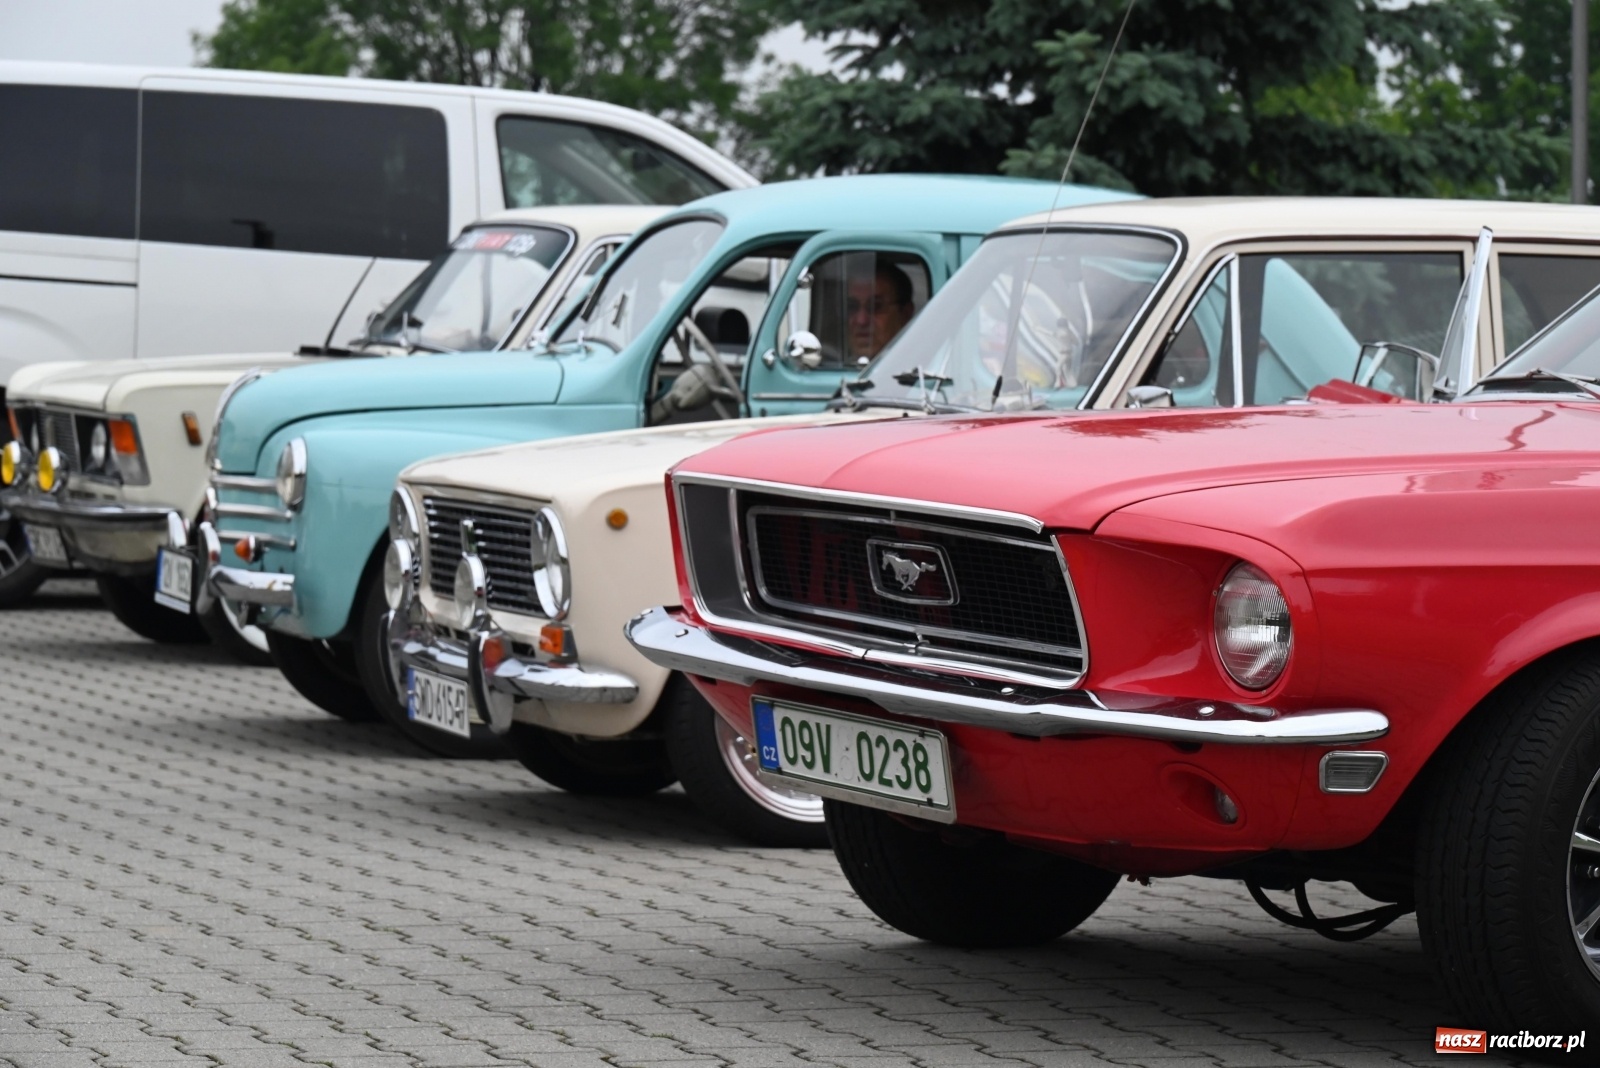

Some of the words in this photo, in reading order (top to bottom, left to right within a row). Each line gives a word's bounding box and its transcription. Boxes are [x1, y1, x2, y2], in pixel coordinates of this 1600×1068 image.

[763, 745, 777, 761] CZ
[780, 716, 831, 774] 09V
[856, 731, 931, 794] 0238
